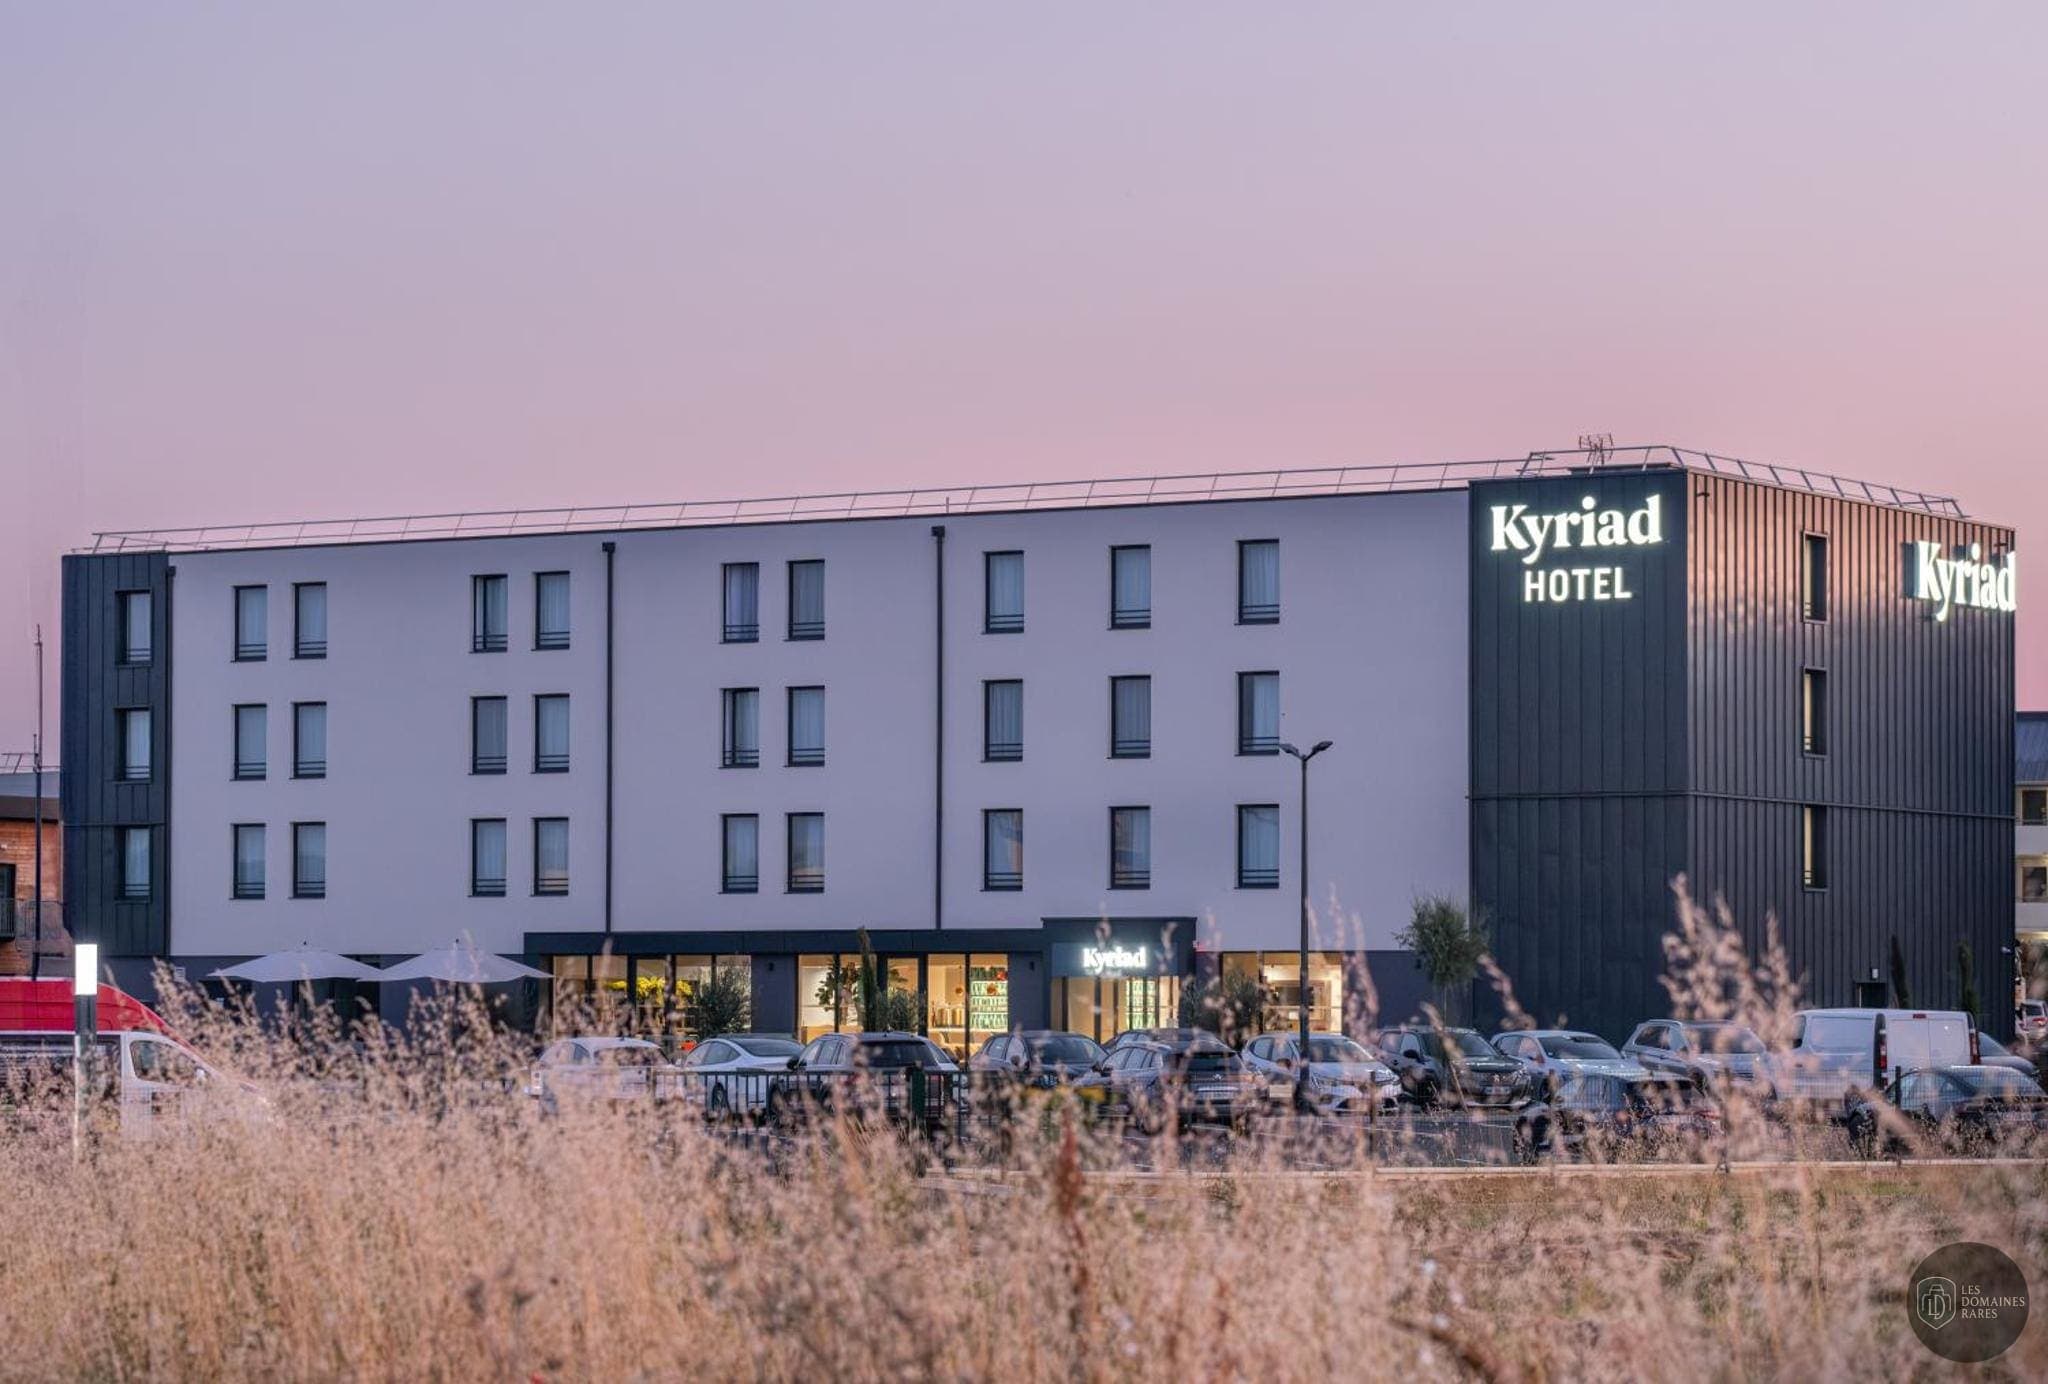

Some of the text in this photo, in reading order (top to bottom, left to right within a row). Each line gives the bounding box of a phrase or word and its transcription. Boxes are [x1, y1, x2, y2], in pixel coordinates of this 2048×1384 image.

[1490, 494, 1663, 564] Kyriad
[1523, 566, 1633, 603] HOTEL
[1917, 540, 2017, 621] Kyriad
[1083, 946, 1146, 973] Kyriad
